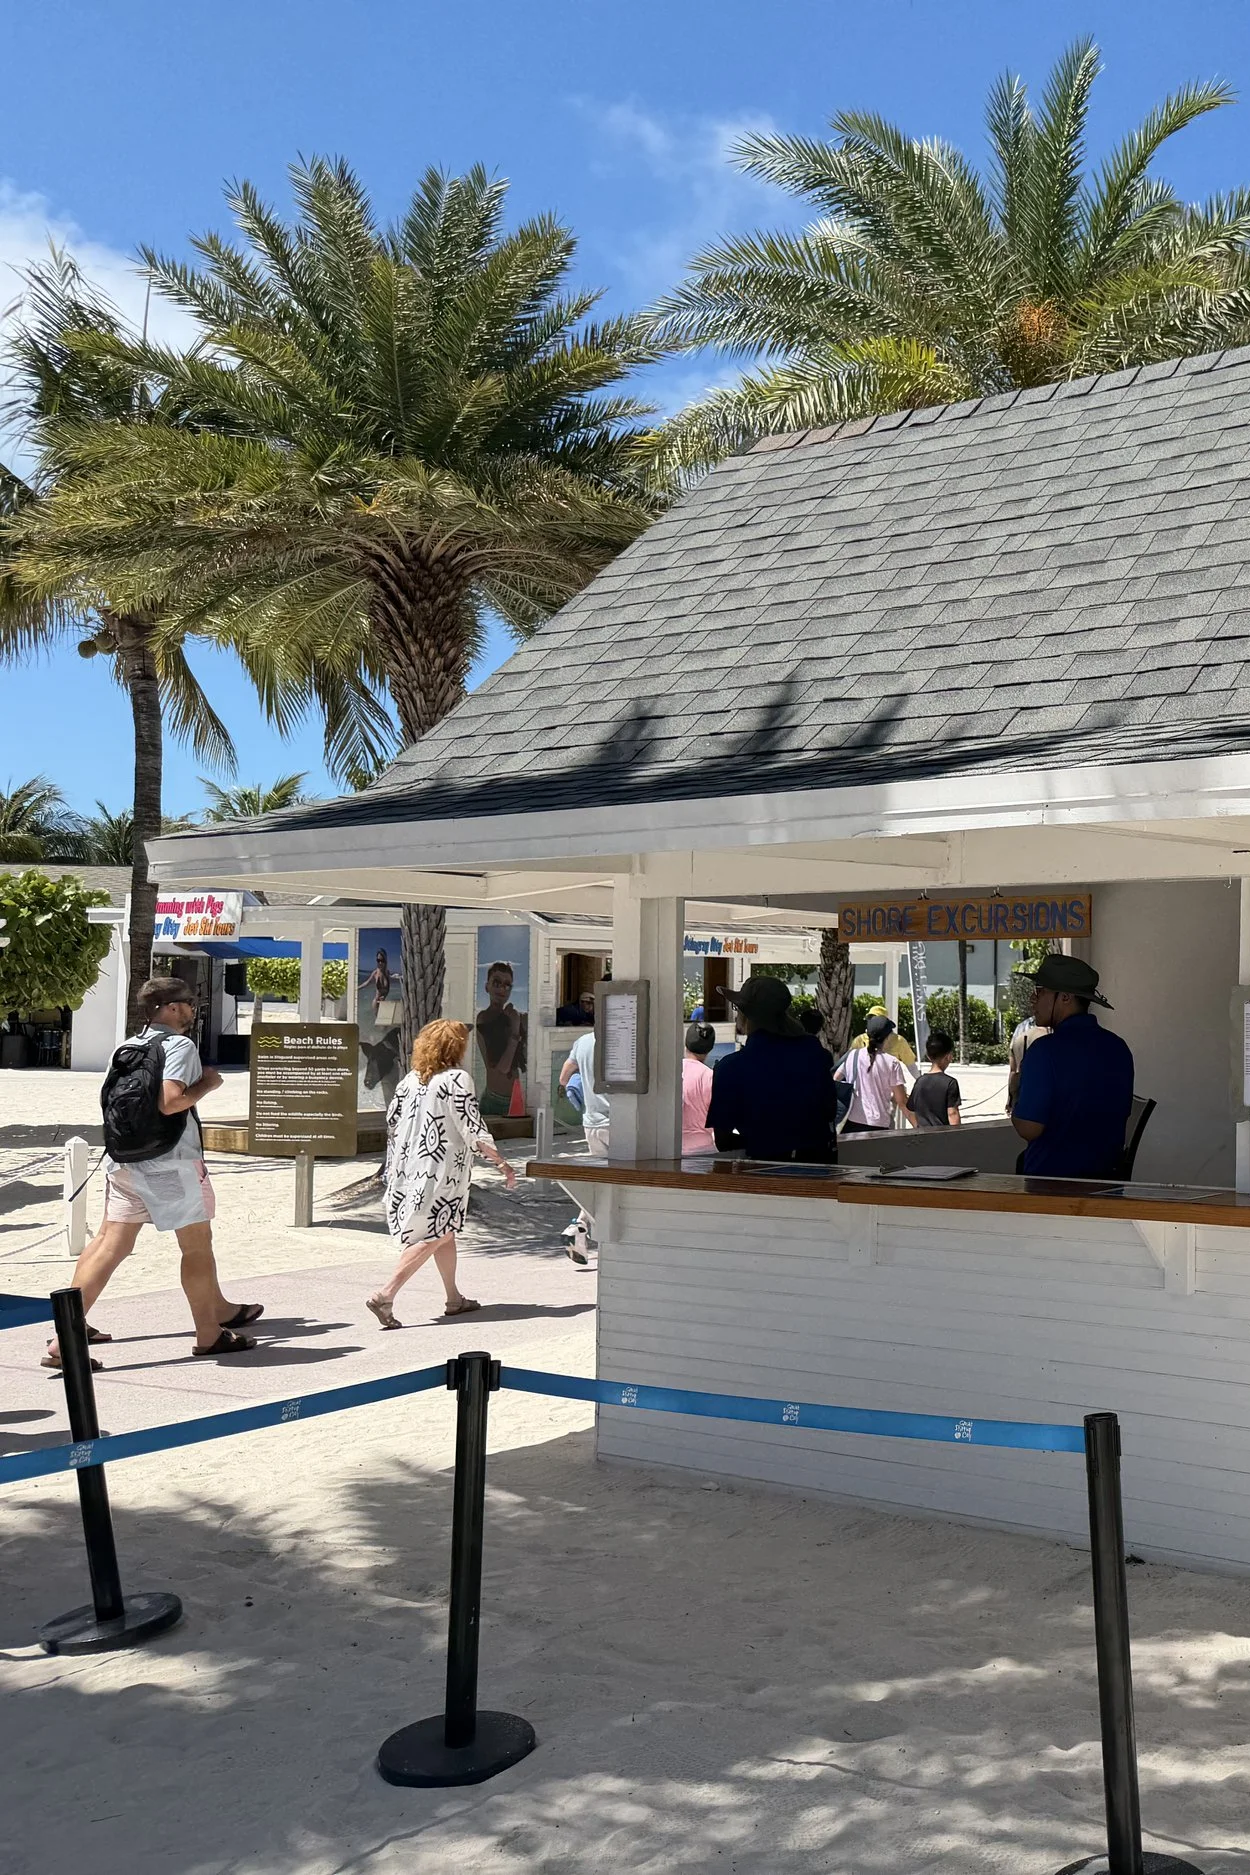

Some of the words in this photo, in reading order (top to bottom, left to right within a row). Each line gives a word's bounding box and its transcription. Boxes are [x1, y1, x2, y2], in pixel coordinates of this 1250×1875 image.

[185, 896, 205, 914] with
[205, 895, 224, 918] Pigs
[842, 905, 917, 936] SHORE
[926, 900, 1086, 936] EXCURSIONS
[184, 916, 199, 936] Jet
[199, 916, 214, 936] Ski
[213, 917, 236, 936] Tours
